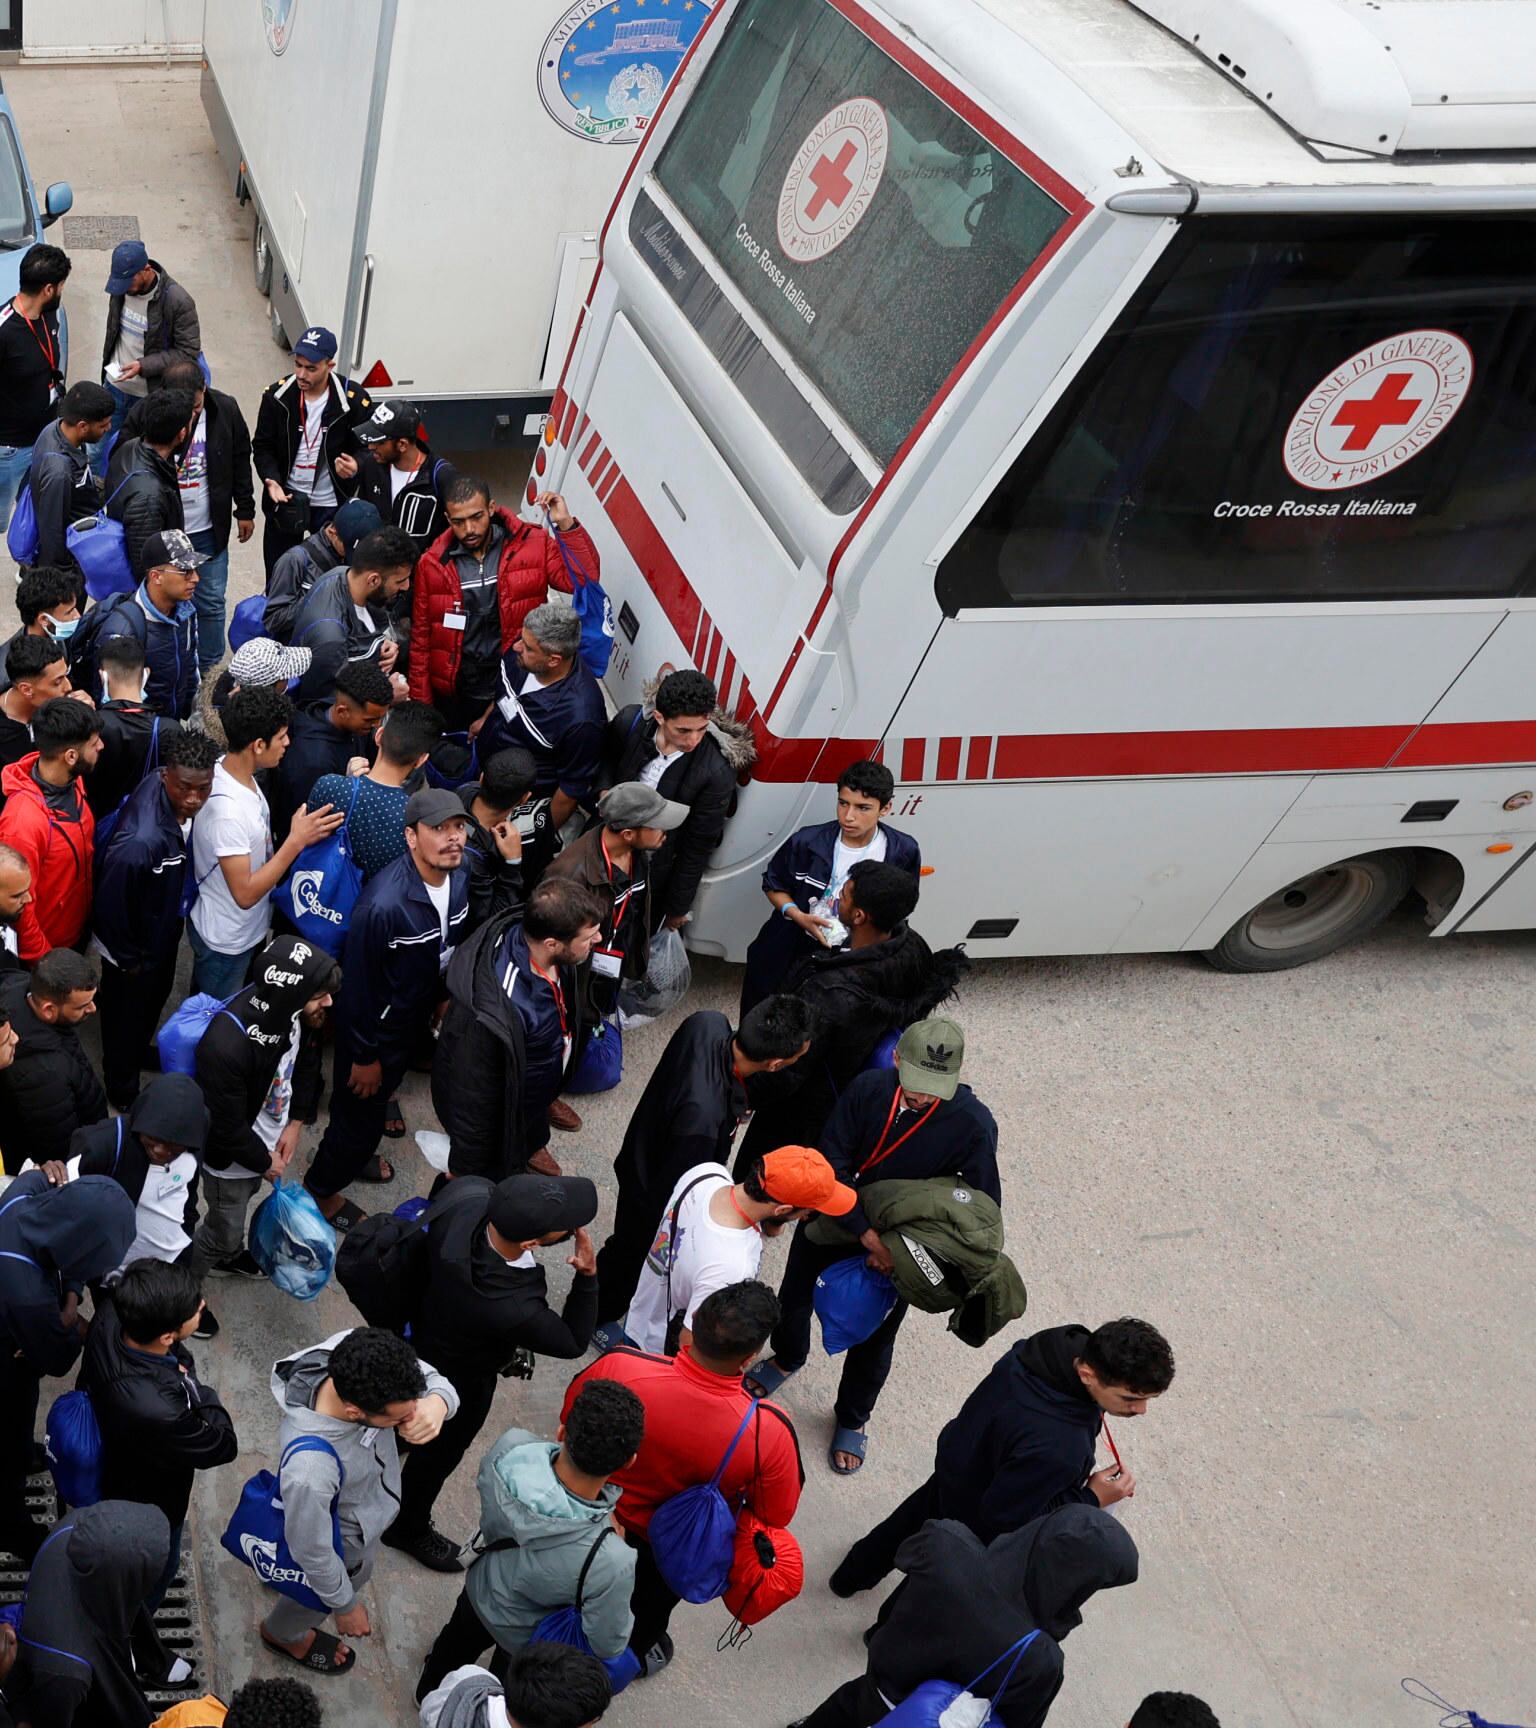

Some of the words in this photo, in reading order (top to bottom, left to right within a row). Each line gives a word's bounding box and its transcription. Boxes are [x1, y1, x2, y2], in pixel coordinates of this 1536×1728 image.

[554, 0, 605, 45] MINIS
[834, 109, 849, 129] DI
[865, 161, 882, 181] 22
[736, 223, 761, 258] Croce
[757, 249, 786, 289] Rossa
[782, 279, 816, 325] Italiana
[1352, 352, 1374, 376] DI
[1381, 337, 1460, 372] GINEVRA
[1444, 366, 1465, 389] 22
[1290, 372, 1350, 482] CONVENZIONE
[1393, 392, 1459, 460] AGOSTO
[1349, 455, 1389, 482] 1864
[1213, 501, 1273, 518] Croce
[1276, 500, 1341, 517] Rossa
[1343, 499, 1417, 517] Italiana
[610, 641, 630, 681] ri.it
[301, 881, 343, 925] Celgene
[912, 1248, 940, 1284] LONDON
